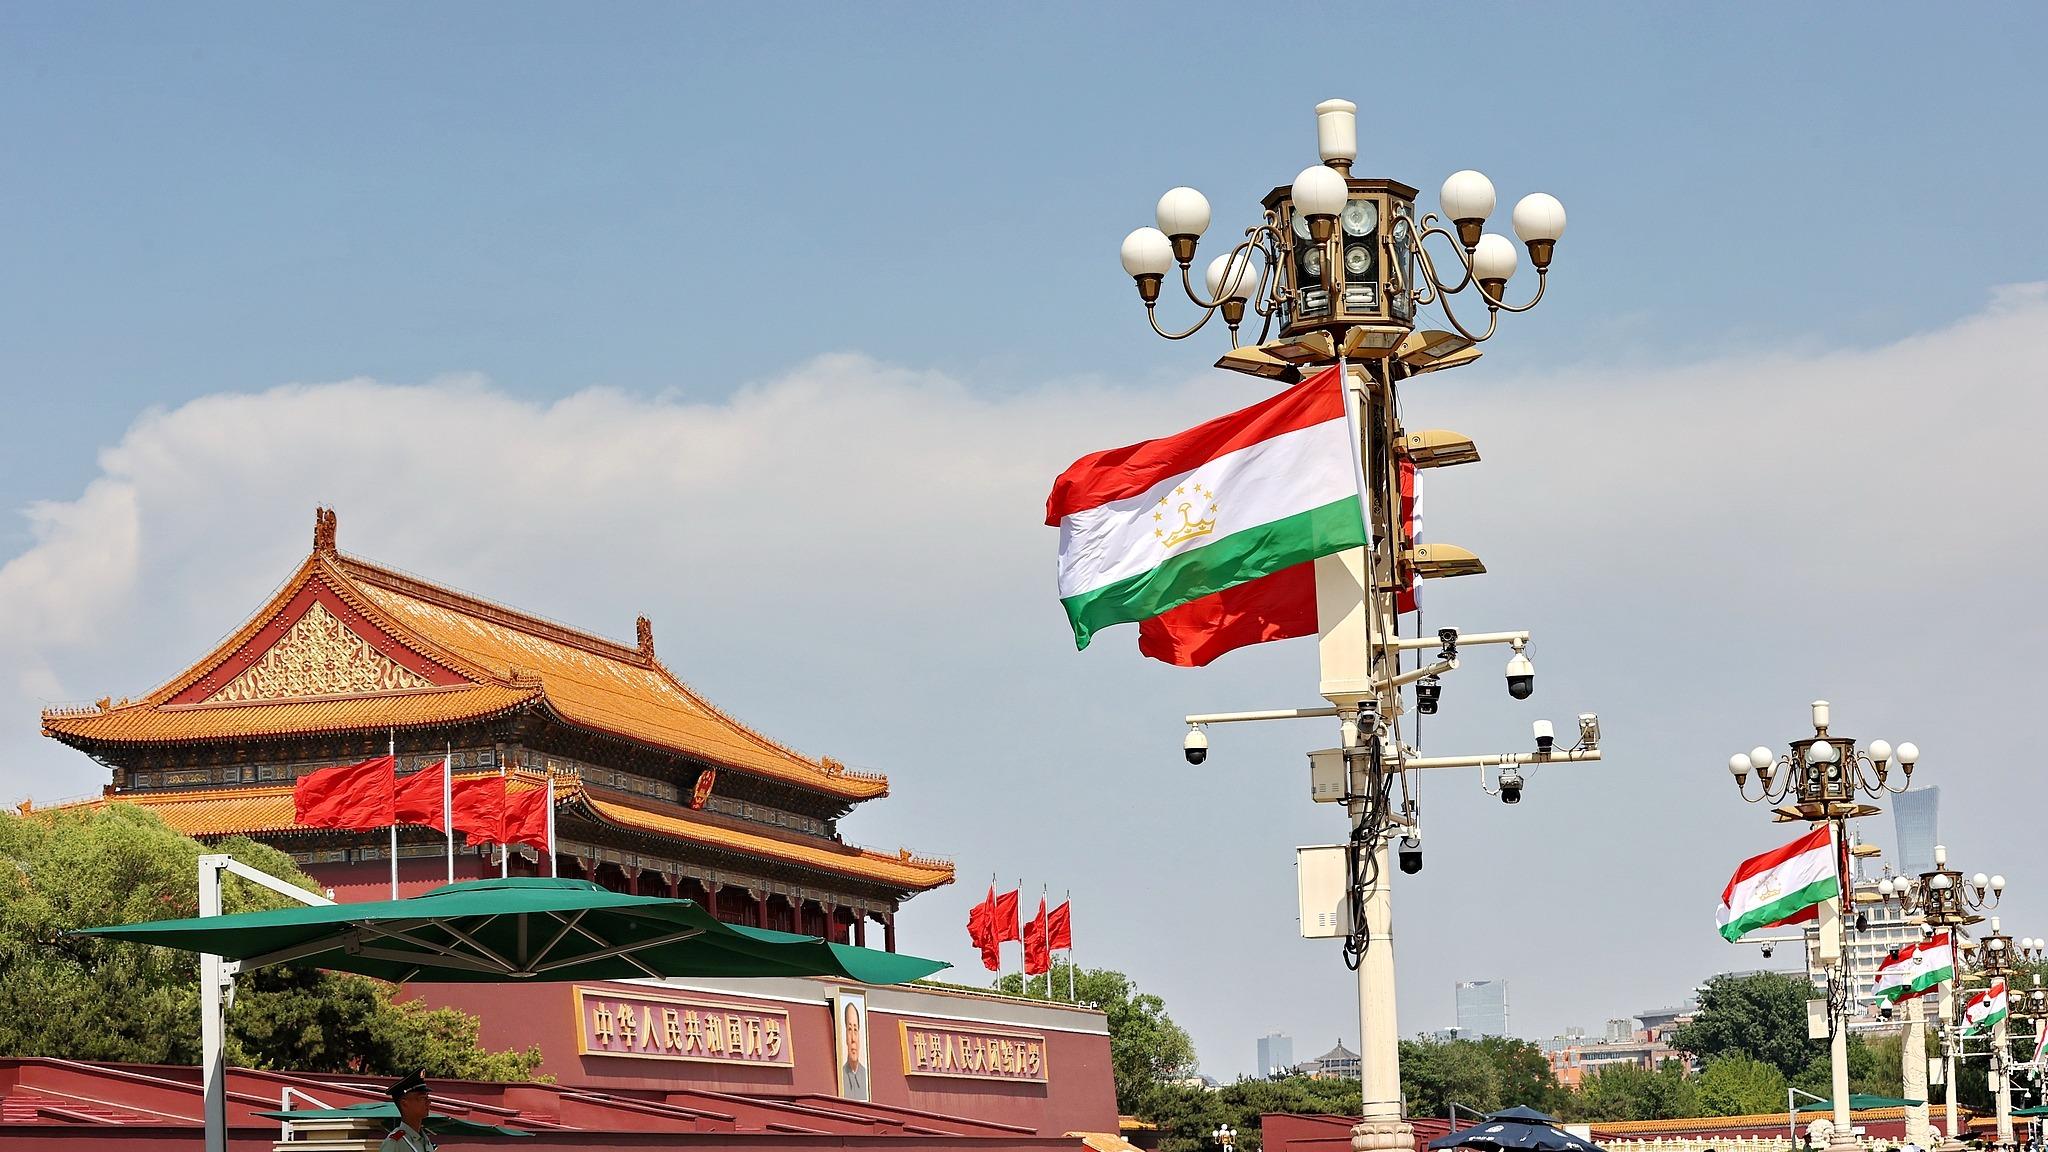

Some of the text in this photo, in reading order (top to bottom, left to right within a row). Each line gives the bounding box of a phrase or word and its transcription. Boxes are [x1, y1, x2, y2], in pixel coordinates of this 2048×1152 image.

[592, 1002, 781, 1057] 中华人民共和国万岁
[913, 1032, 1041, 1074] 世界人民大团结万岁
